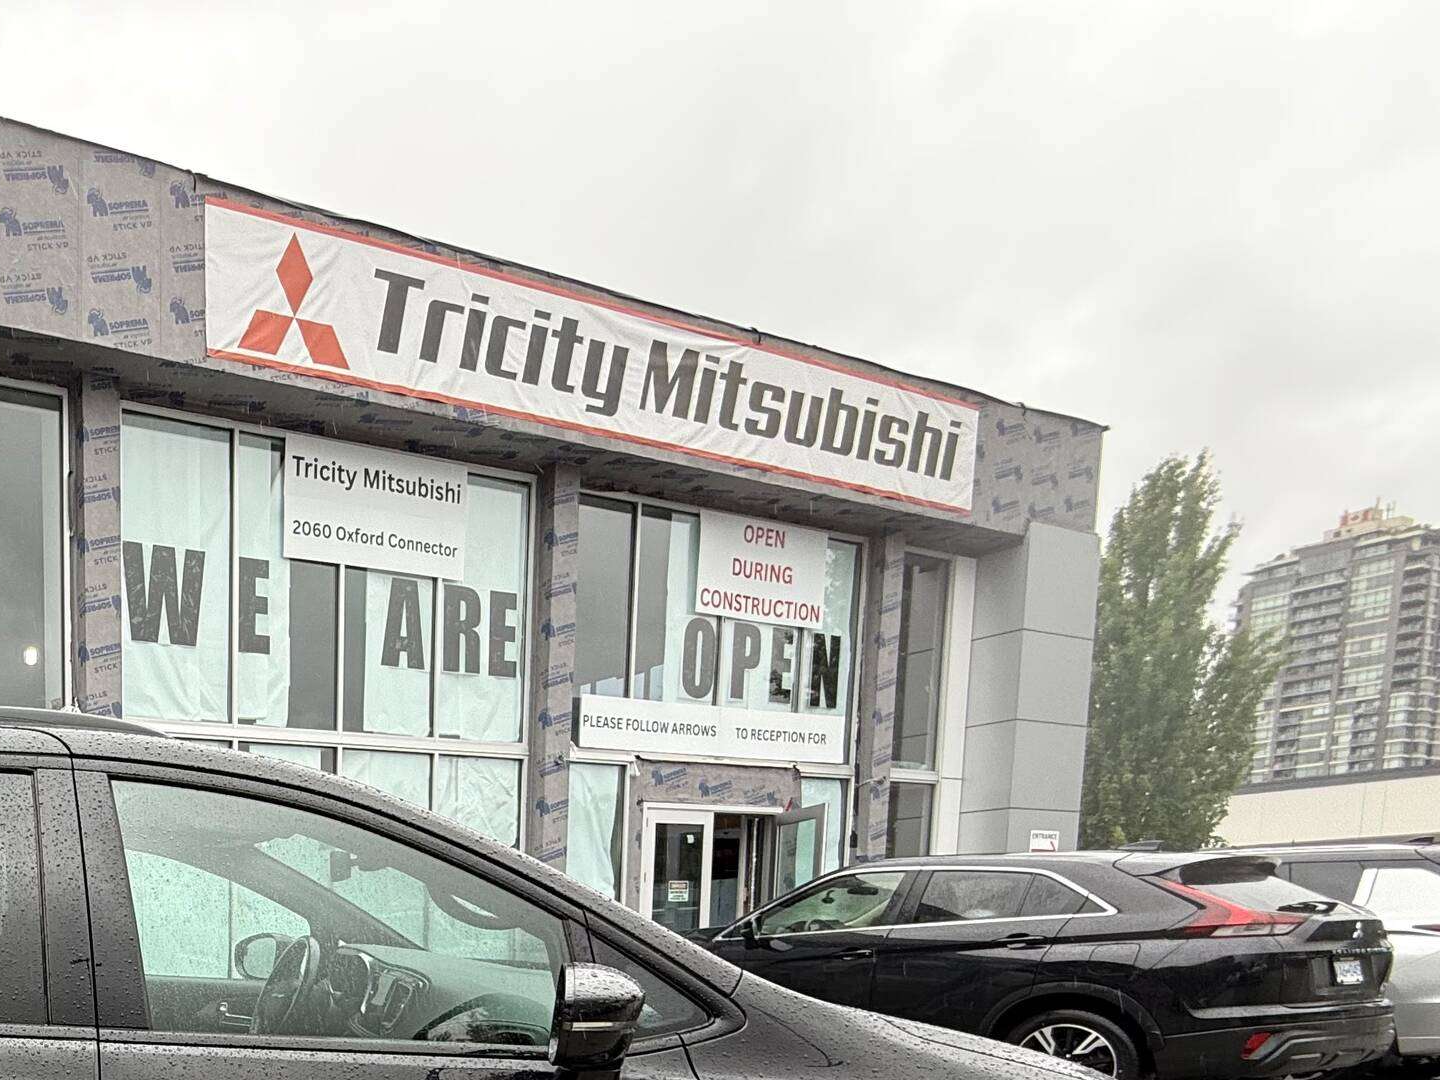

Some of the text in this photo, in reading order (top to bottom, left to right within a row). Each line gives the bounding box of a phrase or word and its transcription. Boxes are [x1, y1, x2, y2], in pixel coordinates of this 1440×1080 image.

[184, 244, 205, 254] TICK
[374, 268, 961, 481] Tricity Mitsubishi
[90, 425, 120, 436] SOPREM
[292, 455, 461, 504] Tricity Mitsubishi
[89, 535, 121, 547] SOPREM
[292, 520, 458, 558] 2060 Oxford Connector
[744, 524, 786, 549] OPEN
[732, 557, 793, 584] DURING
[122, 540, 518, 678] WE ARE
[700, 588, 821, 623] CONSTRUCTION
[90, 643, 121, 656] SOPREM
[681, 617, 841, 709] OPEN
[582, 715, 623, 731] PLEASE
[626, 718, 668, 734] FOLLOW
[671, 721, 717, 738] ARROWS
[736, 727, 748, 740] TO
[751, 728, 805, 744] RECEPTION
[808, 732, 827, 745] FOR
